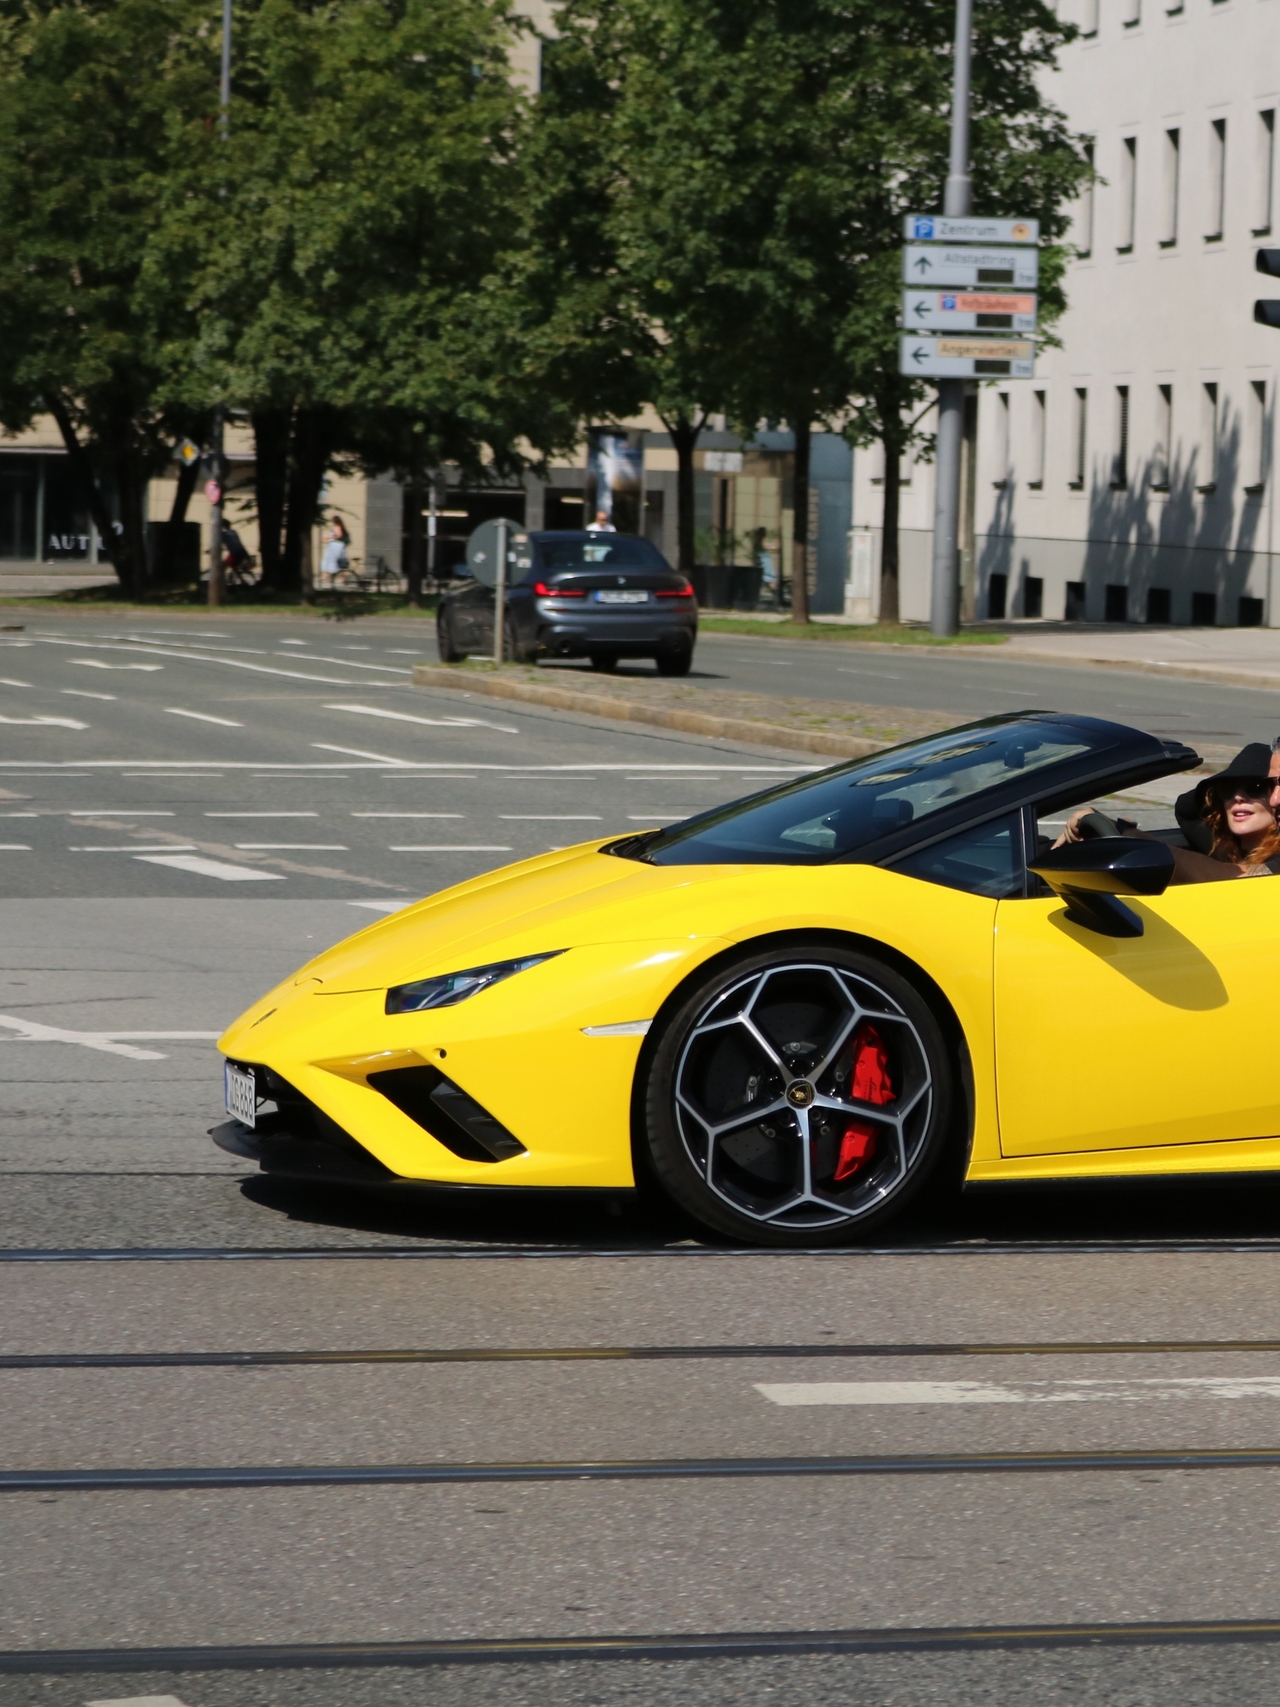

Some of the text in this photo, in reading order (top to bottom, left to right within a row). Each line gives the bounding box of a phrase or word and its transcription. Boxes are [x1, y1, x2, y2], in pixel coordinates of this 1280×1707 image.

[940, 223, 997, 236] Zentrum
[944, 253, 1016, 267] Altstadtring
[941, 343, 1016, 357] Angerviertel
